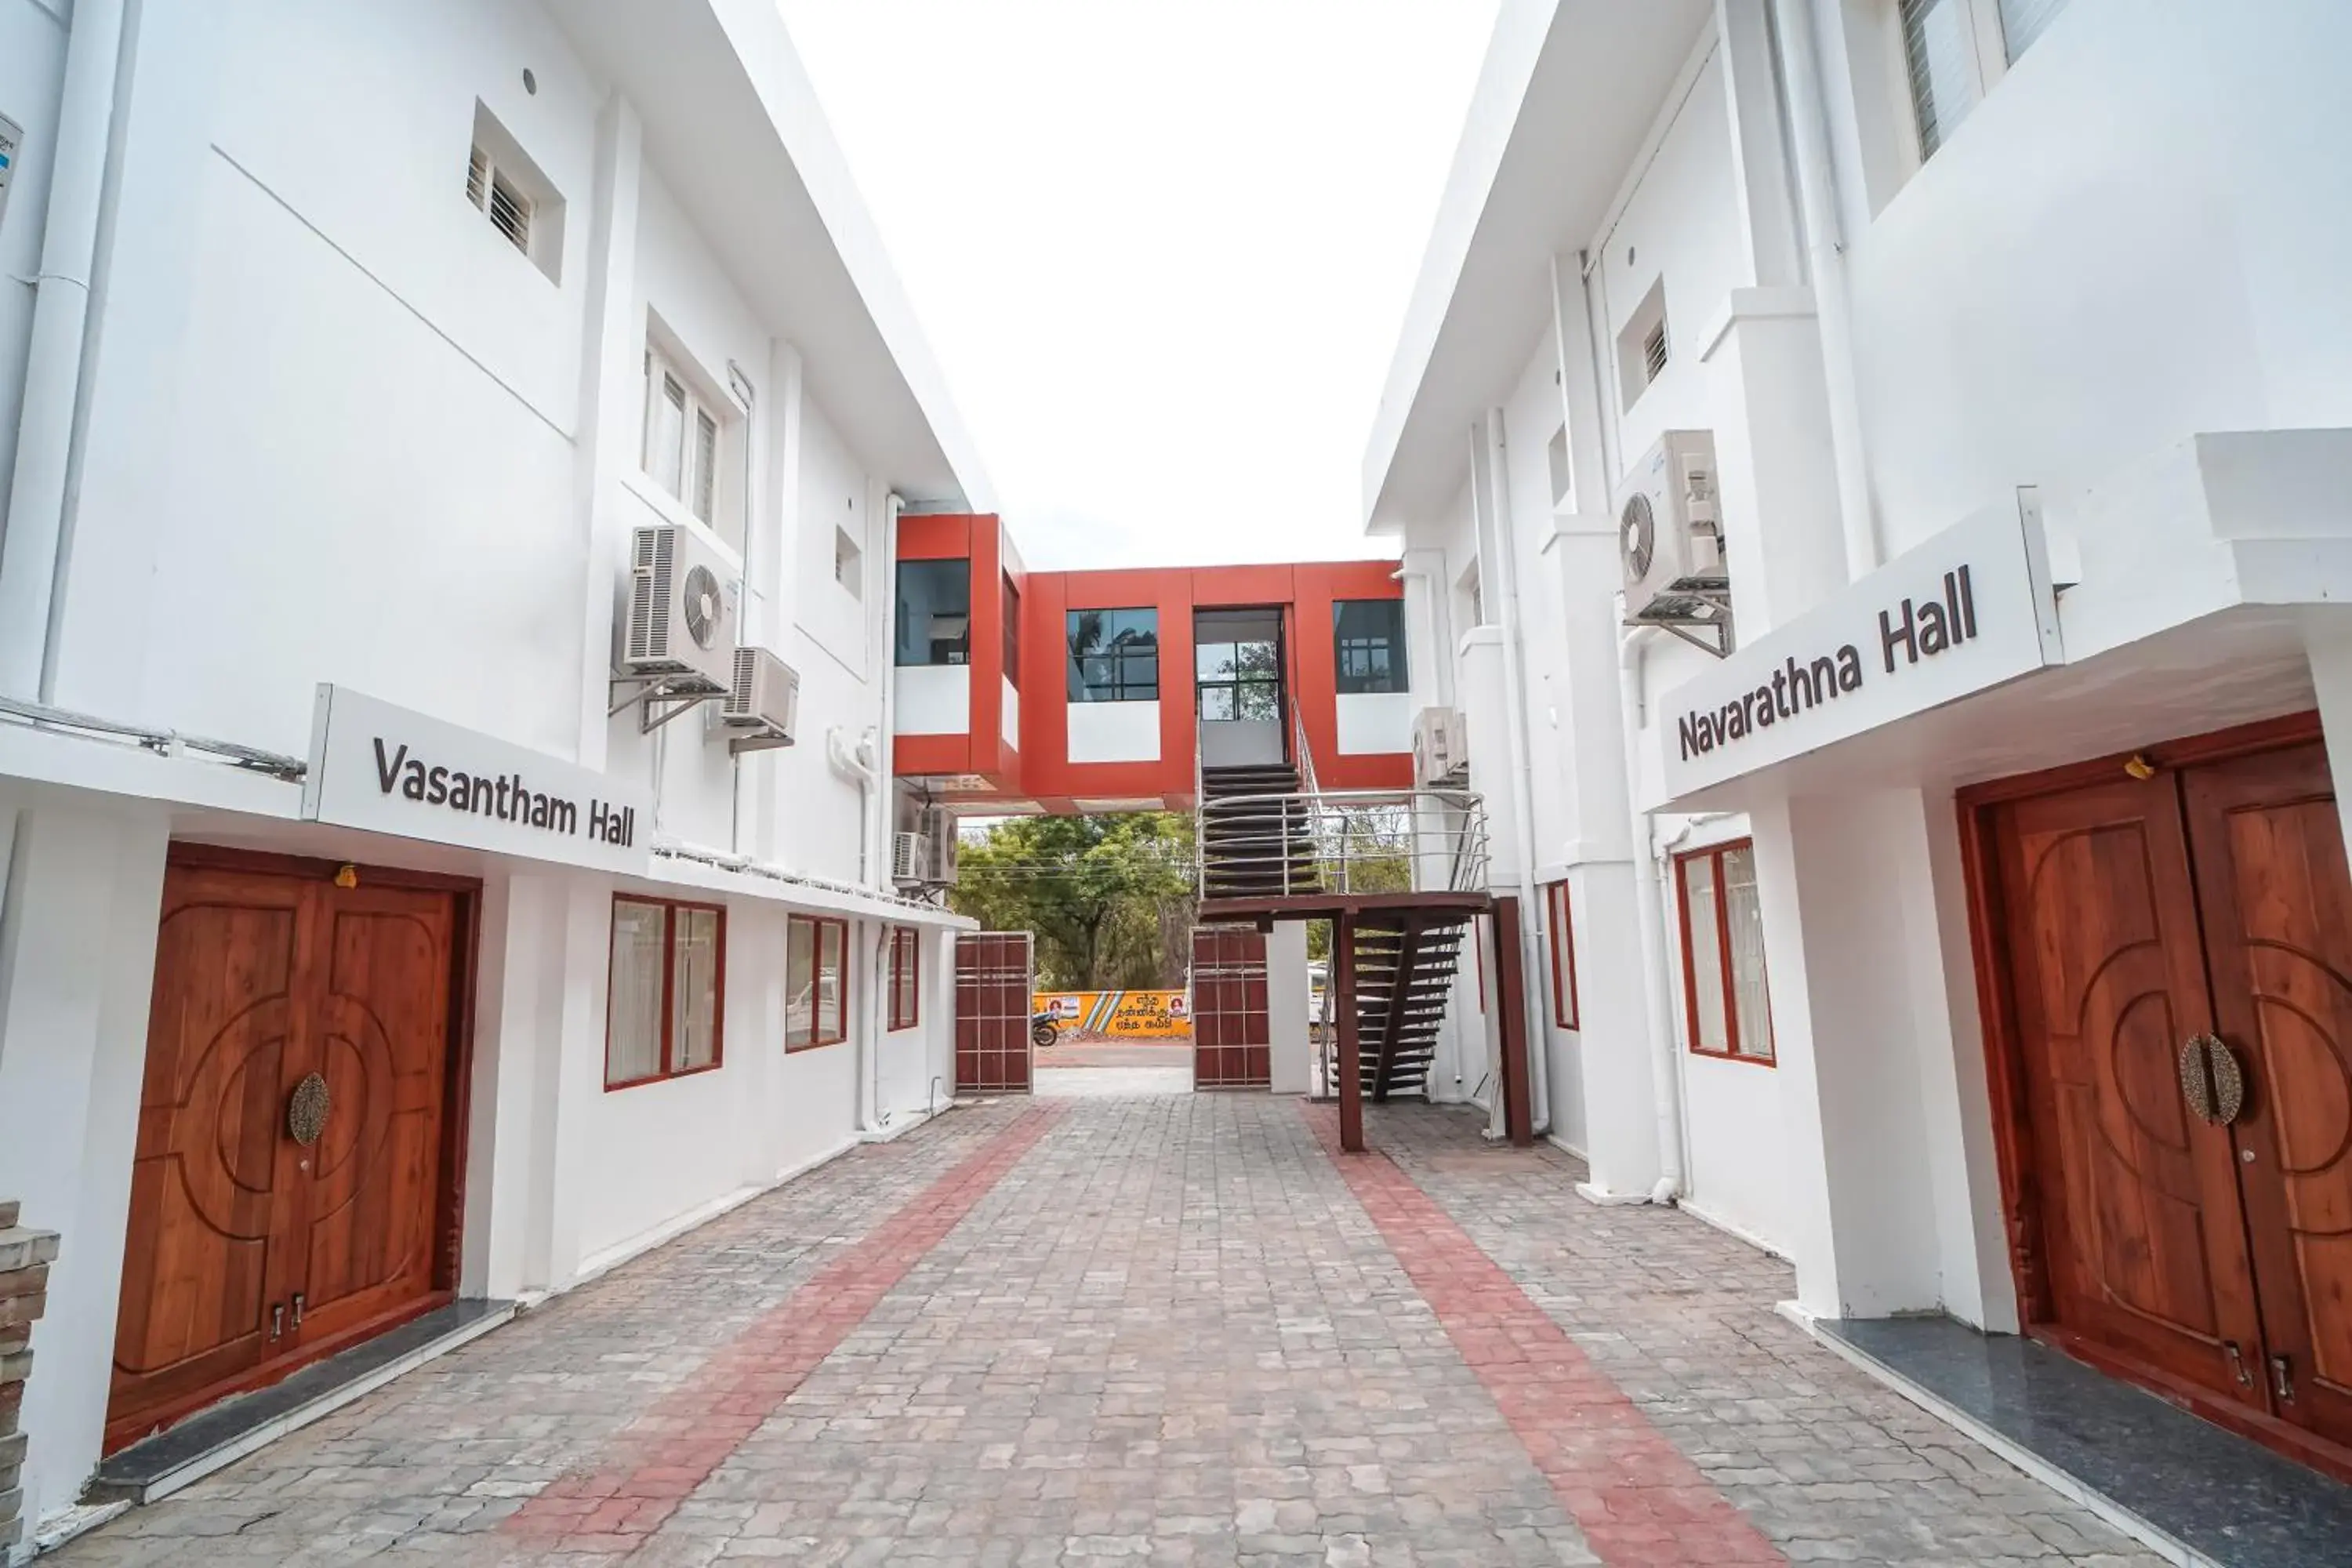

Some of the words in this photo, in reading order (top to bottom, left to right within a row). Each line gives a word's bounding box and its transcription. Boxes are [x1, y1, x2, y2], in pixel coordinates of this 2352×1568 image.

[1679, 644, 1863, 762] Navarathna
[1878, 564, 1977, 673] Hall
[373, 736, 576, 835] Vasantham
[589, 799, 634, 848] Hall
